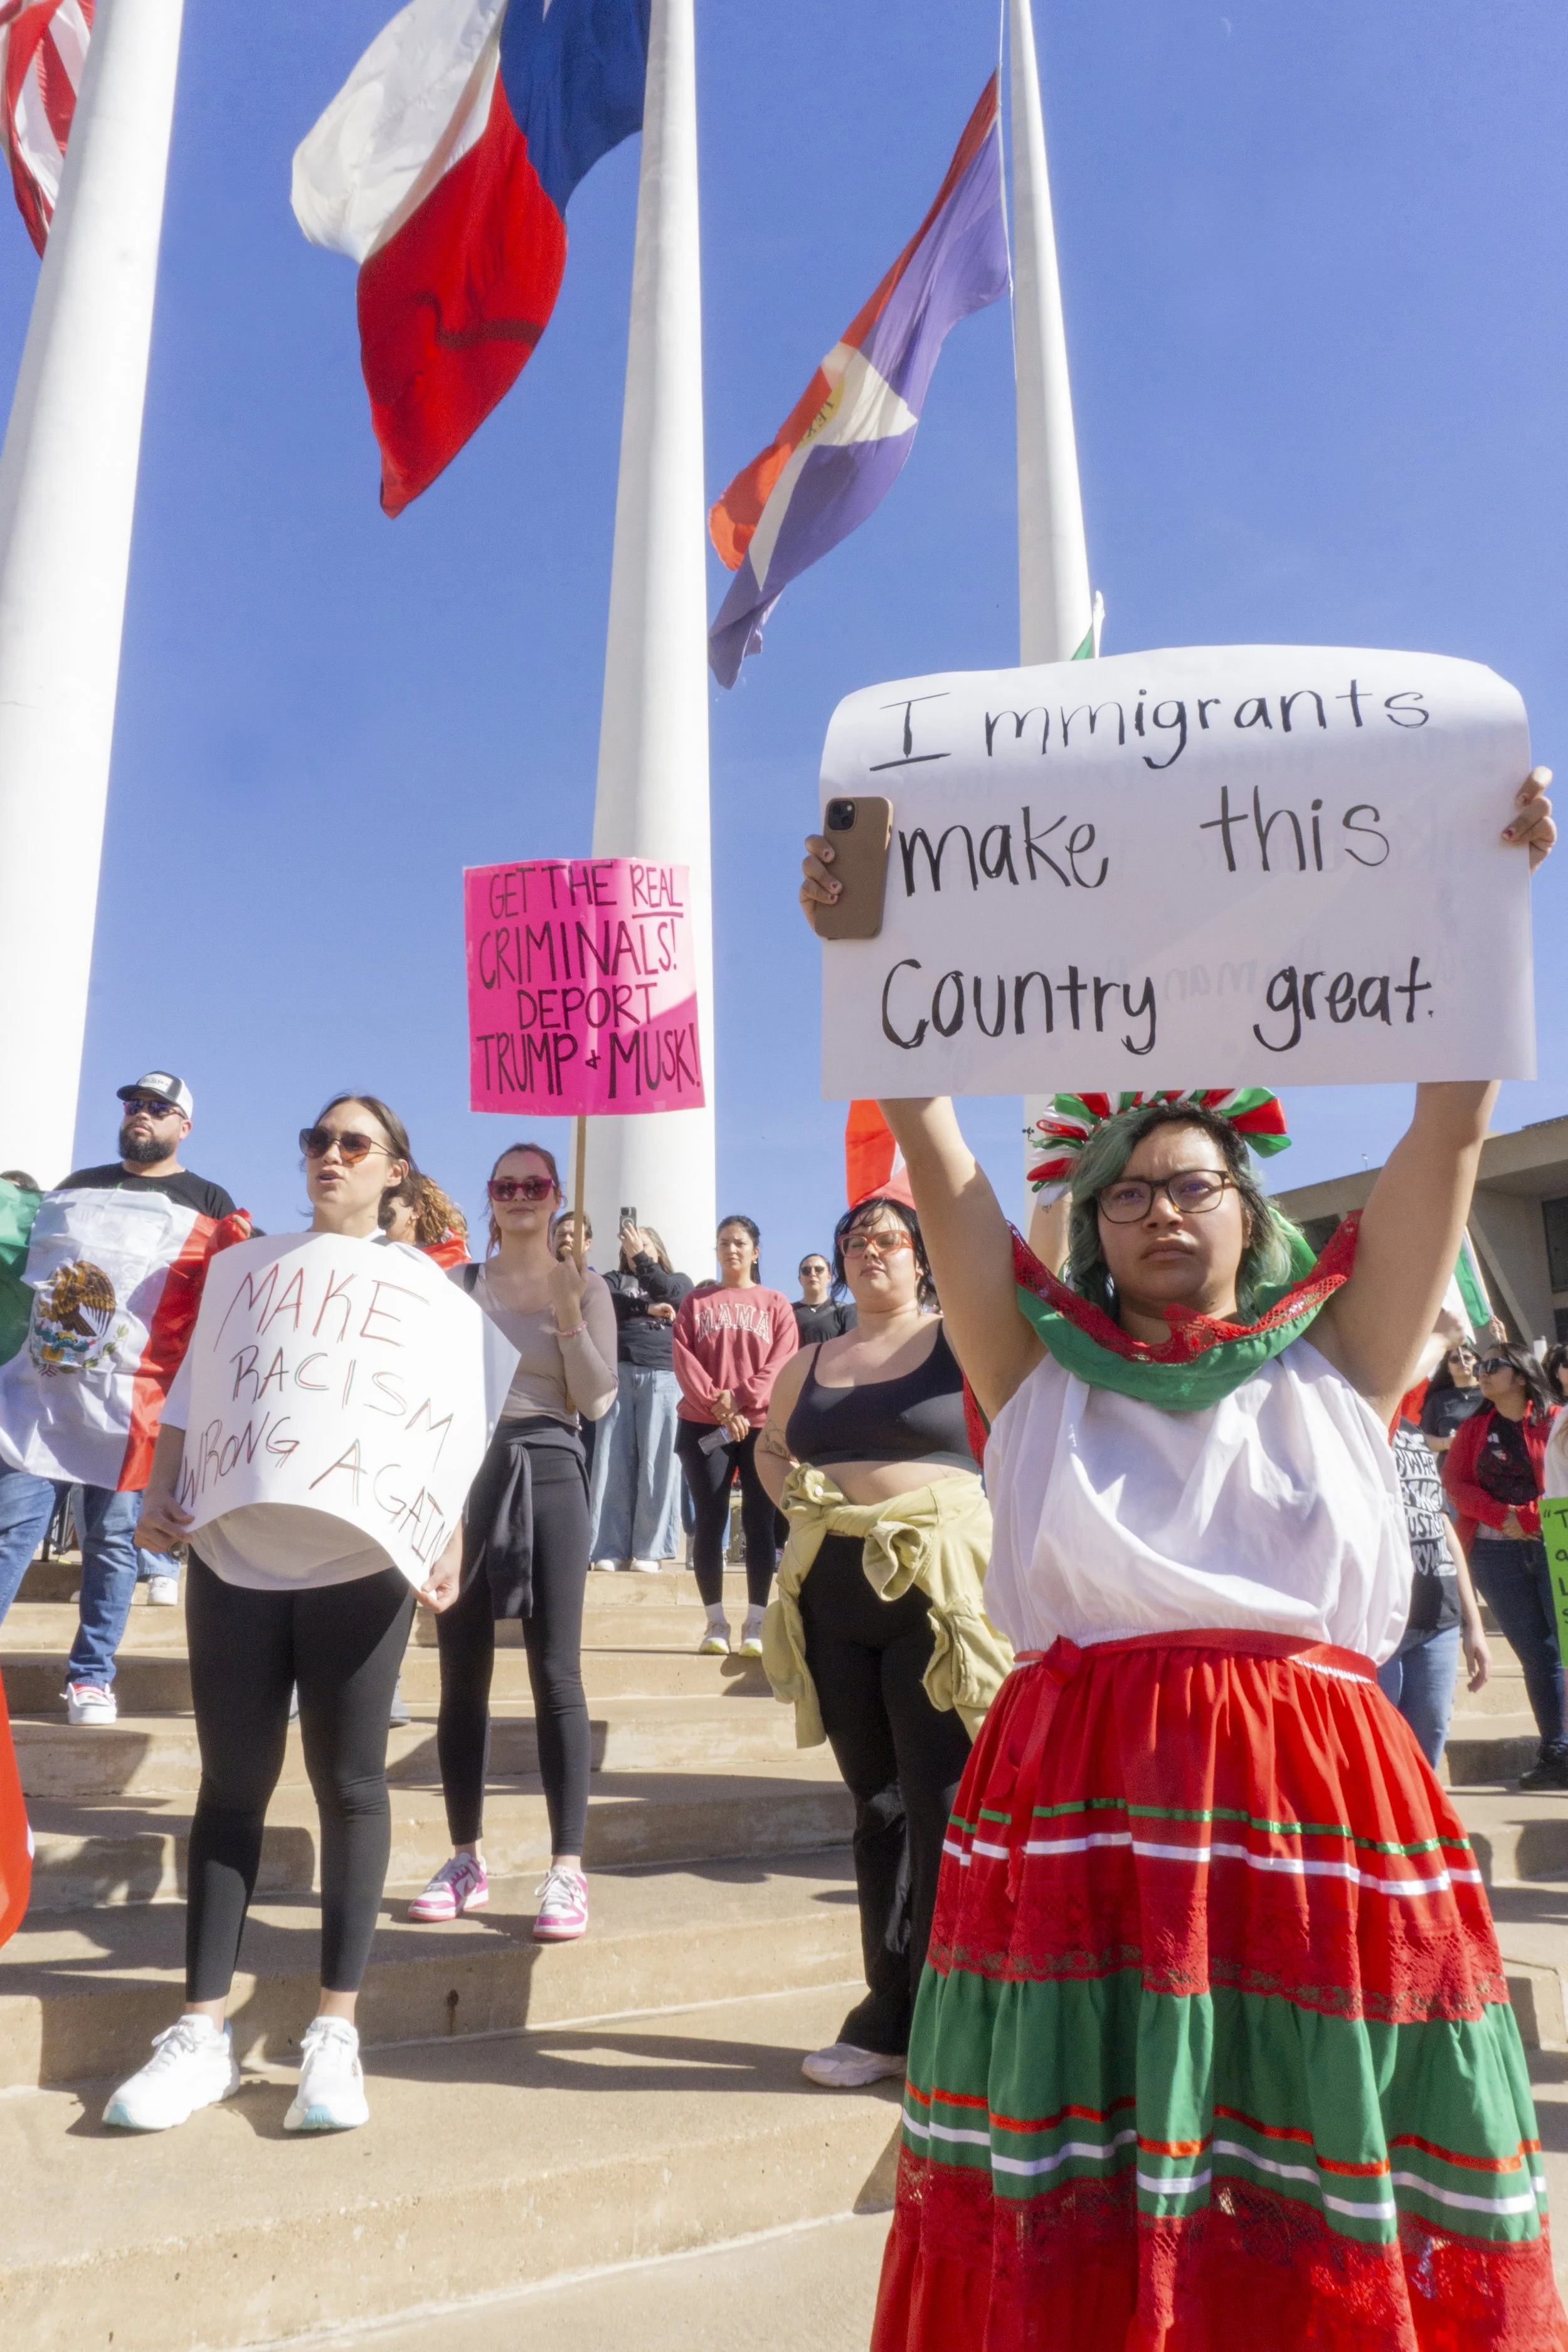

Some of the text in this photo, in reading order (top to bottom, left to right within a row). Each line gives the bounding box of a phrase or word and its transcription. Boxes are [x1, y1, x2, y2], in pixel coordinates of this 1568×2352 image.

[869, 678, 1429, 772] Immigrants
[898, 805, 1109, 898] make
[1199, 783, 1391, 874] this
[489, 862, 684, 920] GET THE REAL
[479, 918, 677, 990] CRIMINALS!
[517, 982, 658, 1030] DEPORT
[881, 957, 1157, 1056] Country
[1253, 955, 1434, 1052] great.
[475, 1032, 578, 1096] TRUMP
[607, 1022, 701, 1099] MUSK!
[213, 1263, 431, 1352] MAKE
[695, 1303, 770, 1345] MAMA
[230, 1345, 454, 1473] RACISM
[179, 1411, 452, 1569] WRONG AGAIN
